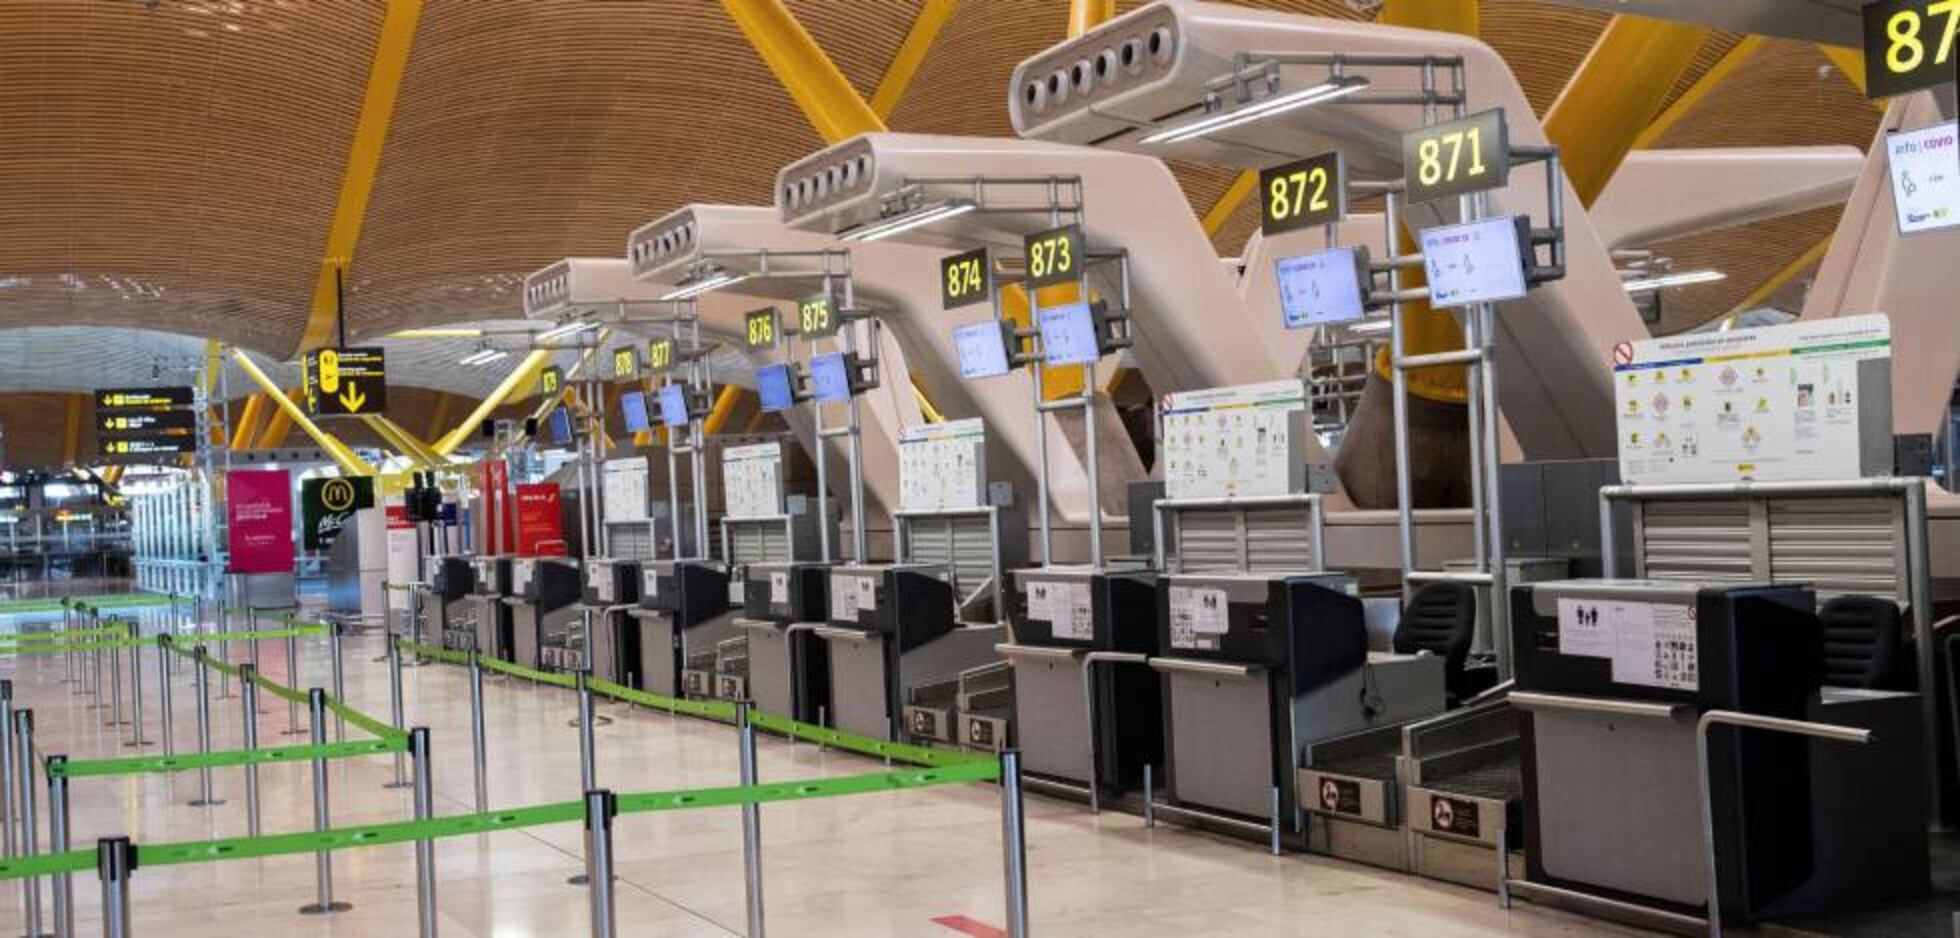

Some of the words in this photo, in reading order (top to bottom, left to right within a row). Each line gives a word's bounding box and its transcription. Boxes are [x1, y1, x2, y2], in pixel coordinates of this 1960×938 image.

[1886, 0, 1960, 73] 87
[1418, 127, 1486, 186] 871
[1270, 167, 1329, 220] 872
[1030, 236, 1071, 278] 873
[947, 258, 982, 297] 874
[748, 317, 772, 346] 876
[801, 301, 828, 332] 875
[615, 350, 633, 376] 878
[650, 341, 670, 369] 877
[542, 371, 558, 393] 879
[318, 511, 350, 534] McC
